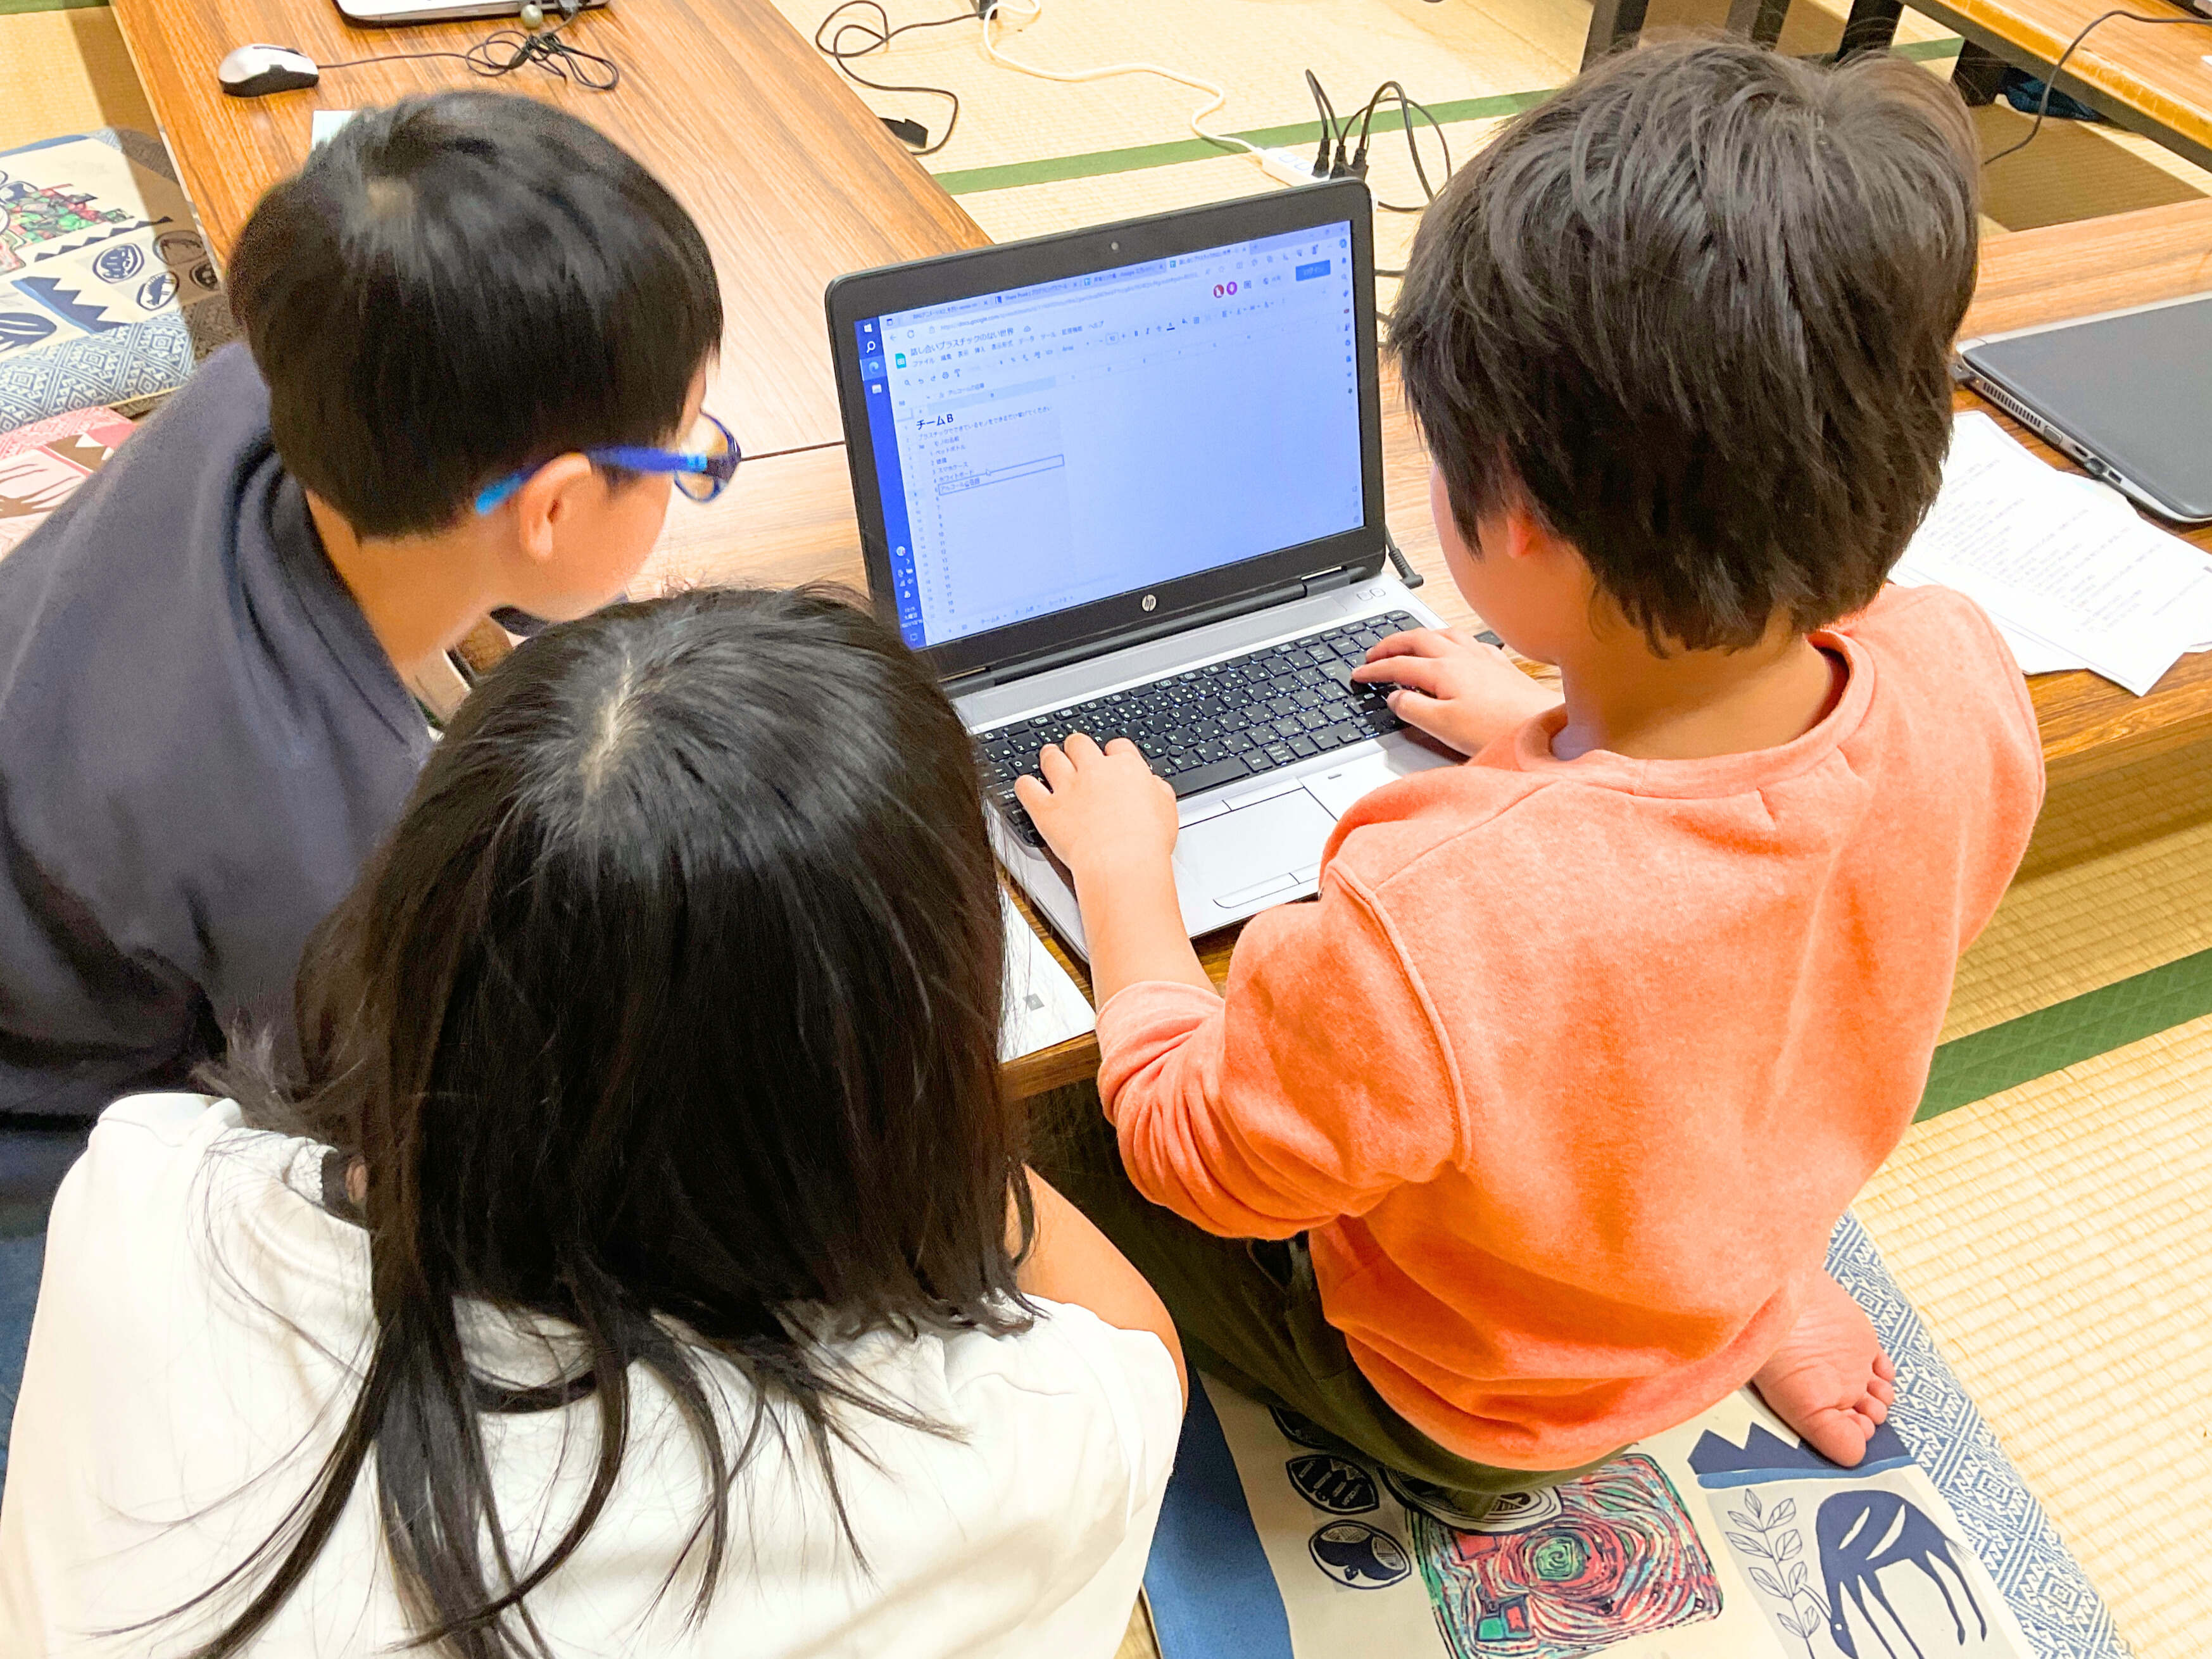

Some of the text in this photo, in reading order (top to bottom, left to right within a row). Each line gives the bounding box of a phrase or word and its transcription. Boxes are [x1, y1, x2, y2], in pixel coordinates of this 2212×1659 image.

[910, 327, 1014, 356] 話し合いプラスチックのない世界
[1143, 594, 1155, 612] hp
